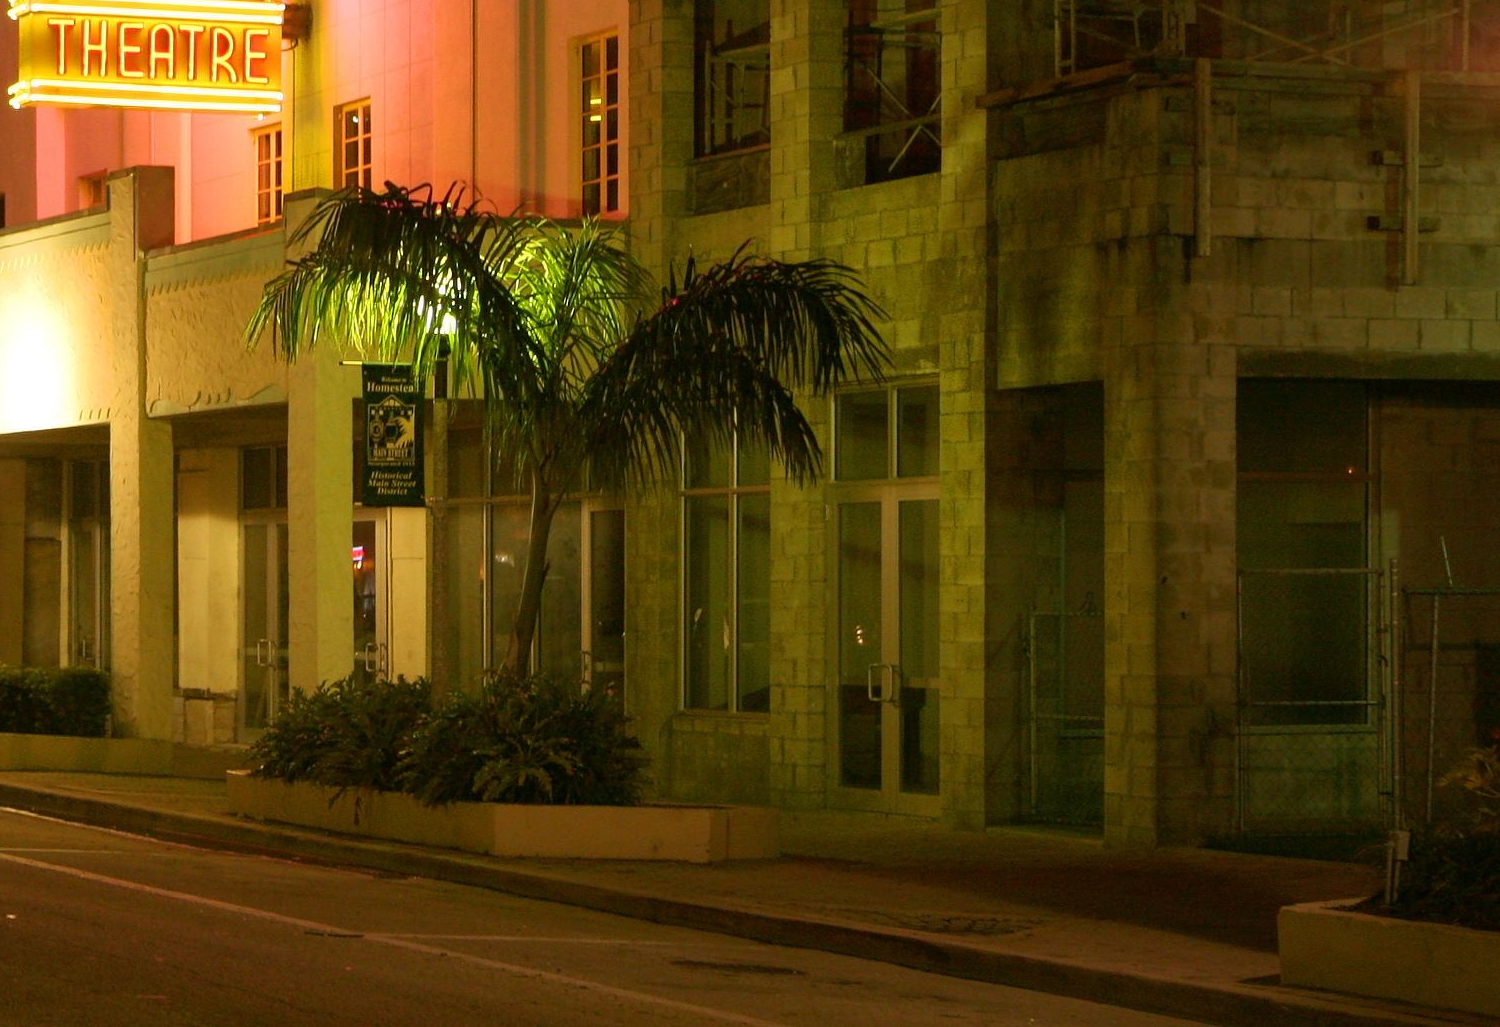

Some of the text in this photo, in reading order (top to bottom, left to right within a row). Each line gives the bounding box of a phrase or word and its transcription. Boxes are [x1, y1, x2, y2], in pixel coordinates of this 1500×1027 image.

[48, 18, 270, 84] THEATRE
[371, 470, 412, 480] Historical
[368, 479, 416, 488] Main Street
[377, 487, 407, 495] District
